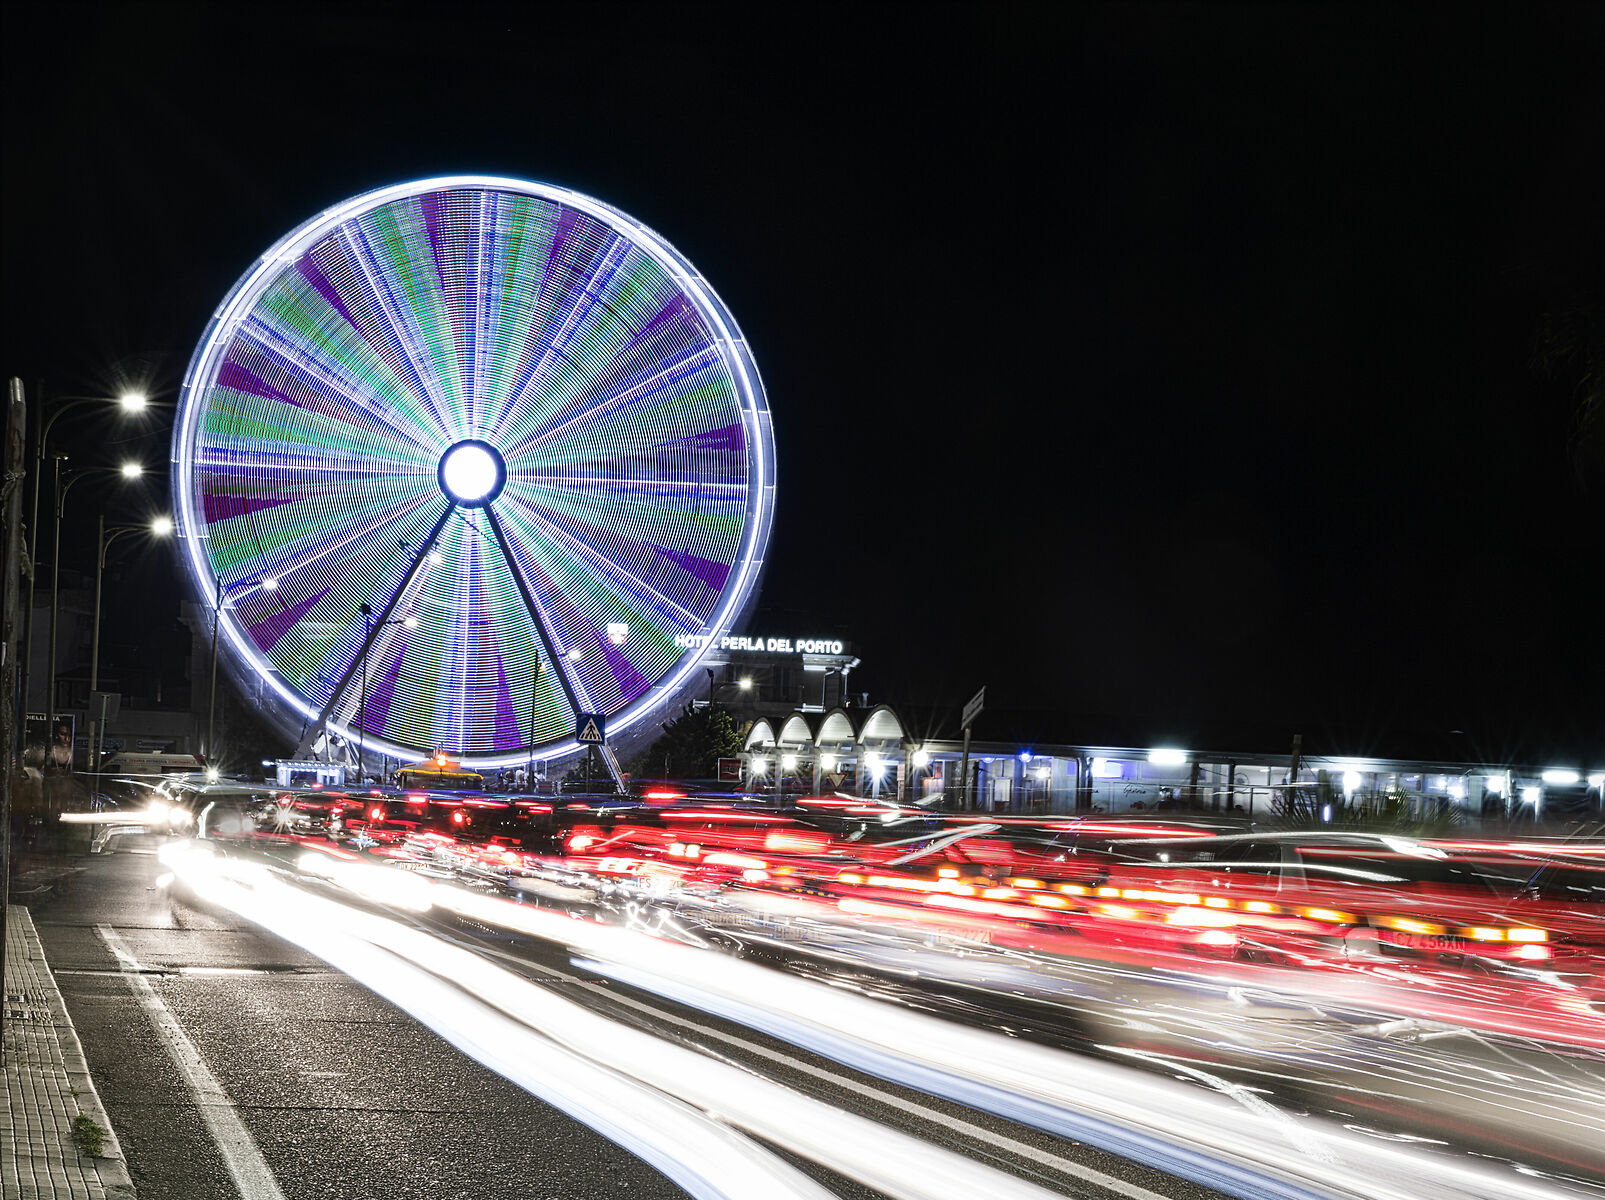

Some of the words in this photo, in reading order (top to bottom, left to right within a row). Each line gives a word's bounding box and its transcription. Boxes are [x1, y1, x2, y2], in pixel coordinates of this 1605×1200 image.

[721, 636, 765, 650] PERLA
[767, 638, 794, 652] DEL
[796, 639, 842, 654] PORTO
